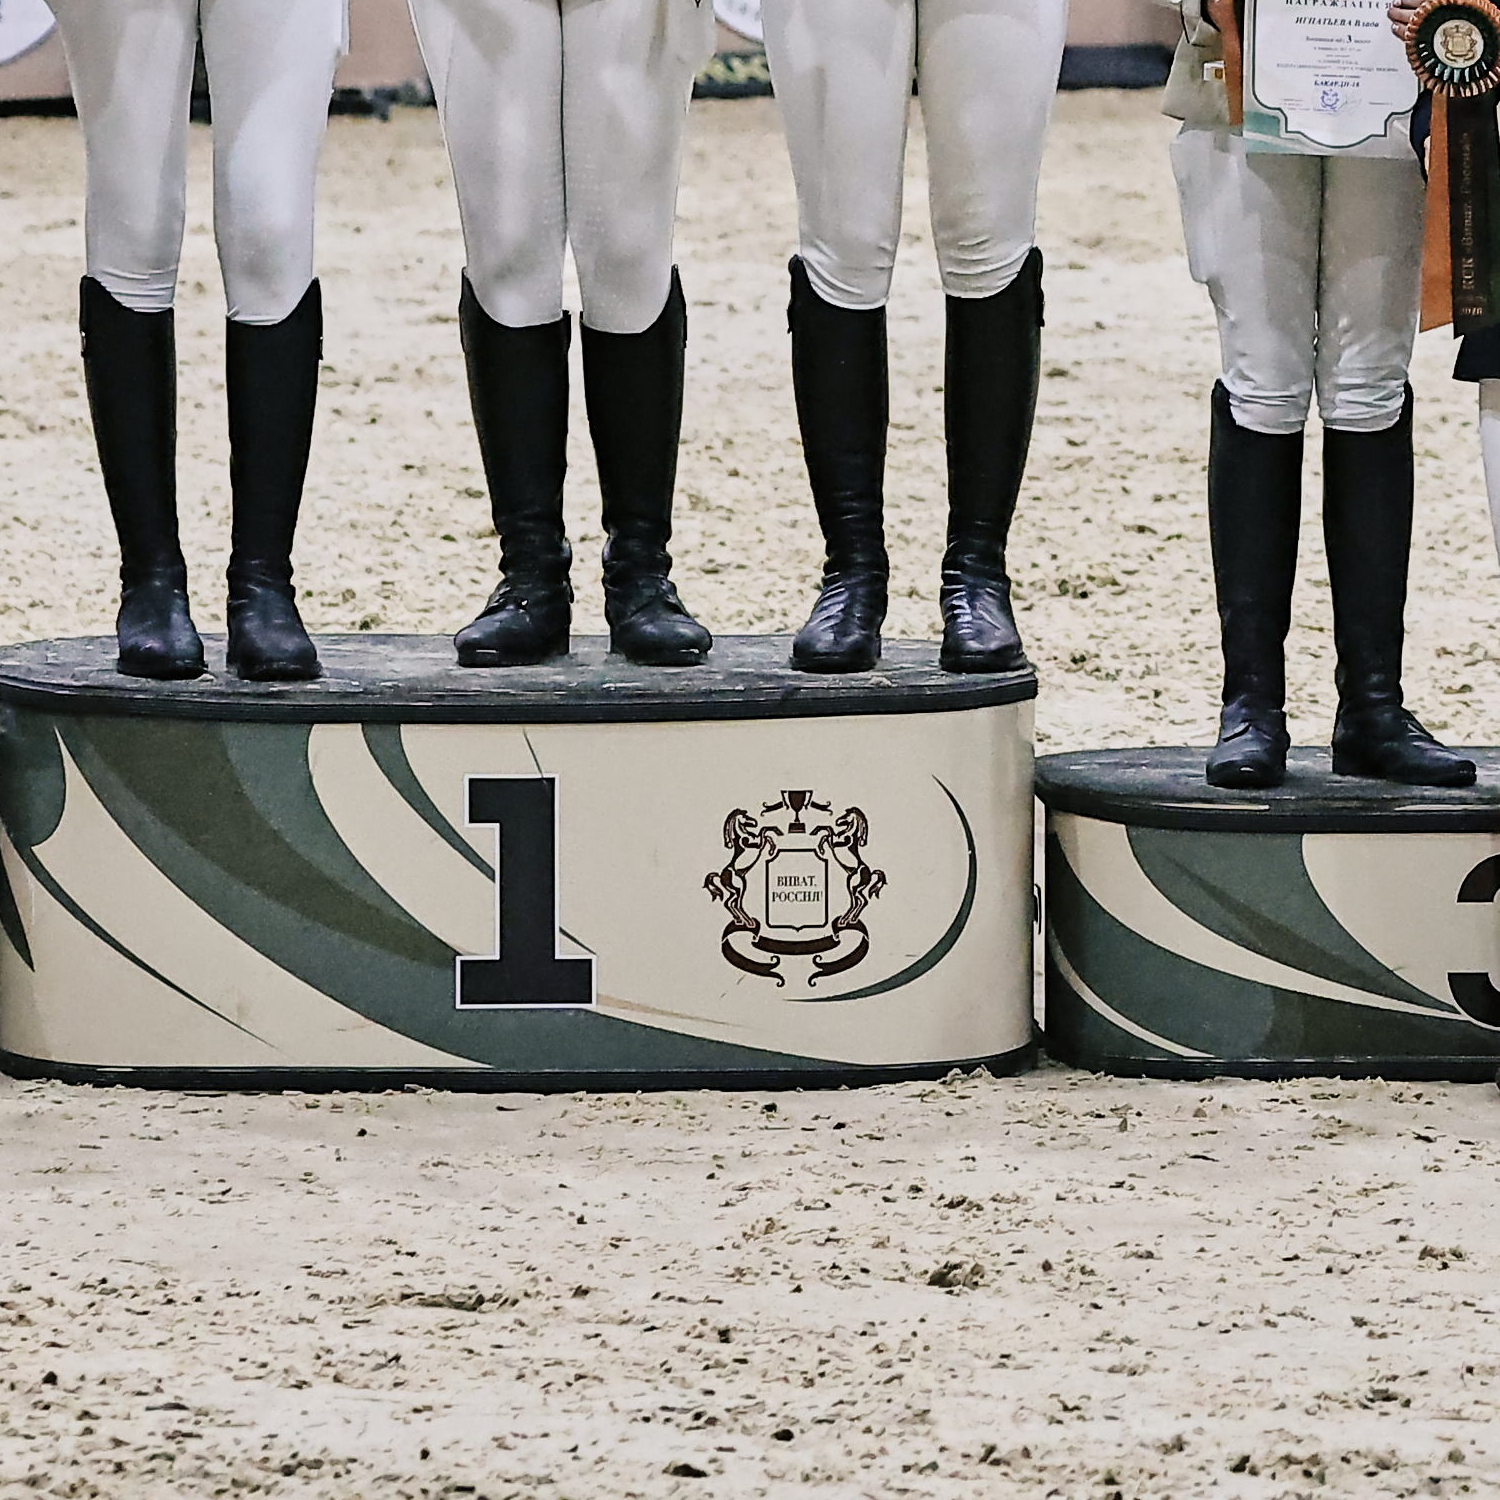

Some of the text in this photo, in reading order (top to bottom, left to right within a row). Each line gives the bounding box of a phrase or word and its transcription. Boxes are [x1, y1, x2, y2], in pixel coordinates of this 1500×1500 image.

[1295, 16, 1352, 27] ИГНАТЬЕВА
[776, 874, 818, 888] ВИВАТ,
[455, 772, 597, 1010] 1
